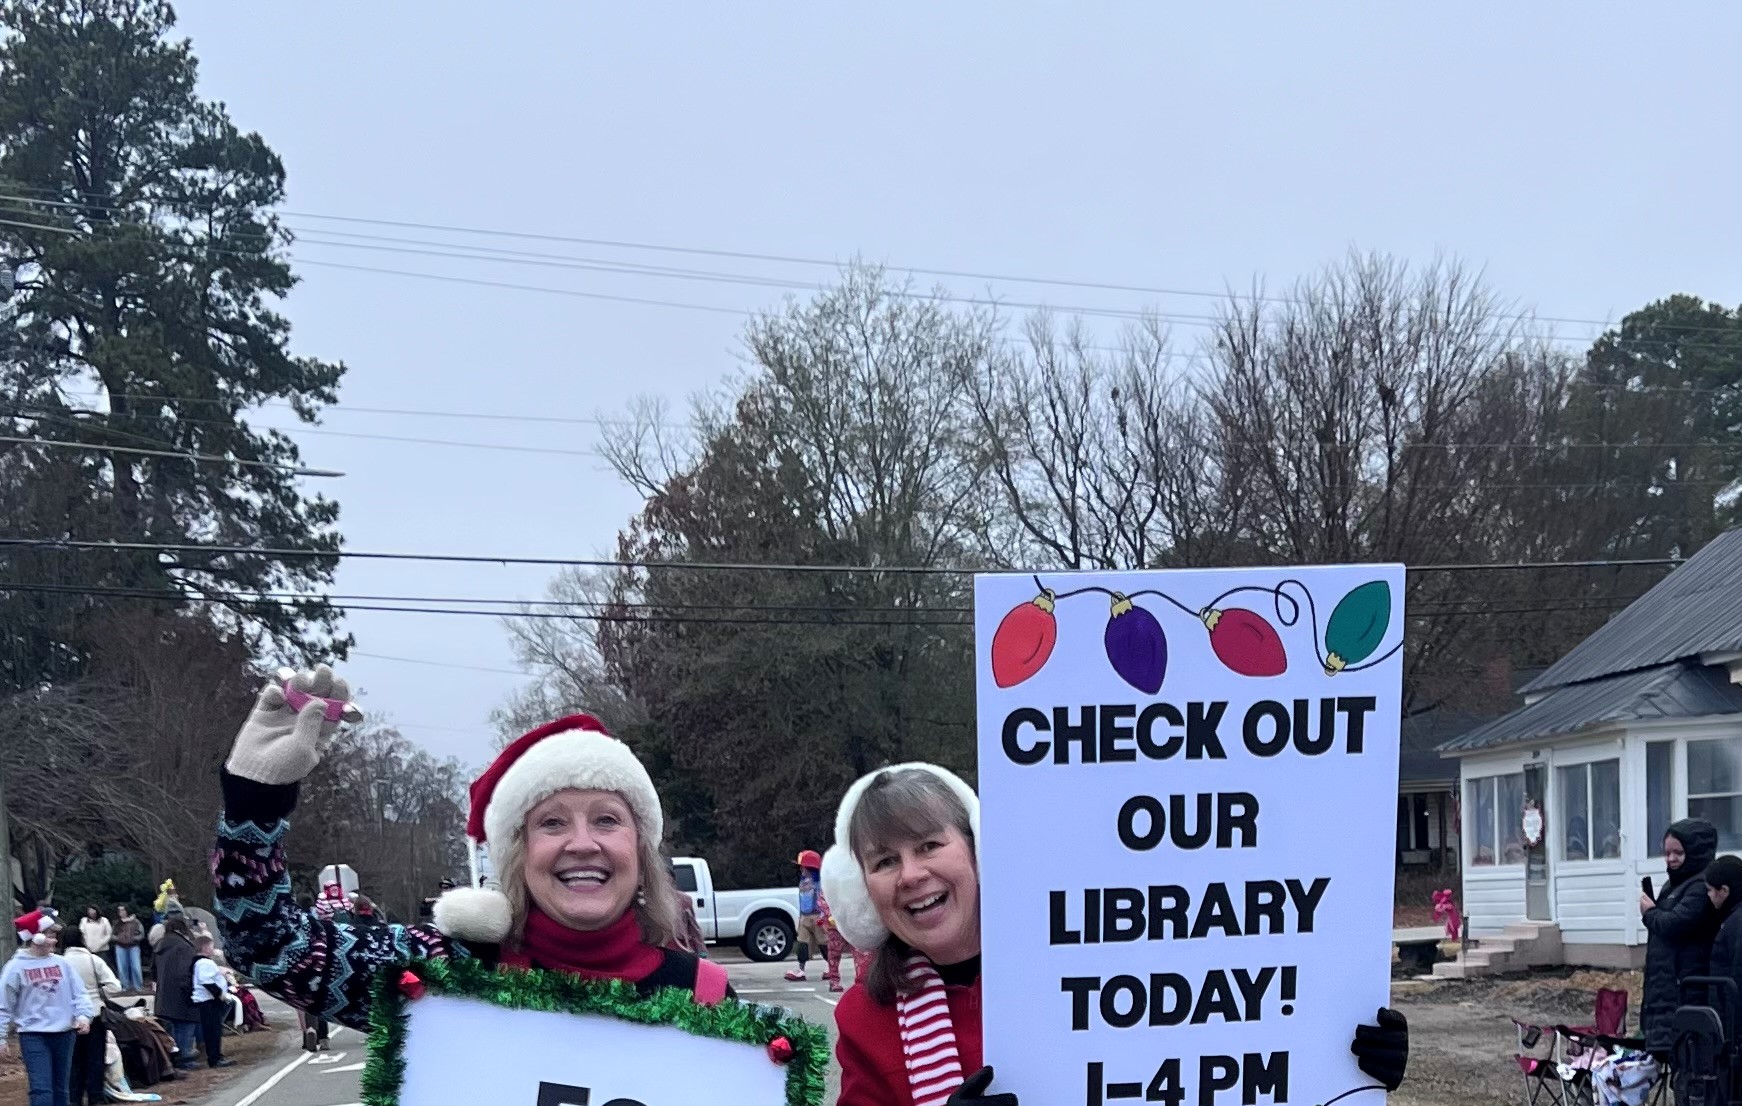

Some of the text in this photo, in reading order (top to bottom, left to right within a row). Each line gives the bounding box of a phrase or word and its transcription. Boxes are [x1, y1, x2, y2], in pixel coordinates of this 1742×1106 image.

[1002, 697, 1376, 765] CHECK OUT
[1118, 792, 1259, 851] OUR
[1050, 878, 1330, 945] LIBRARY
[1062, 966, 1297, 1031] TODAY!
